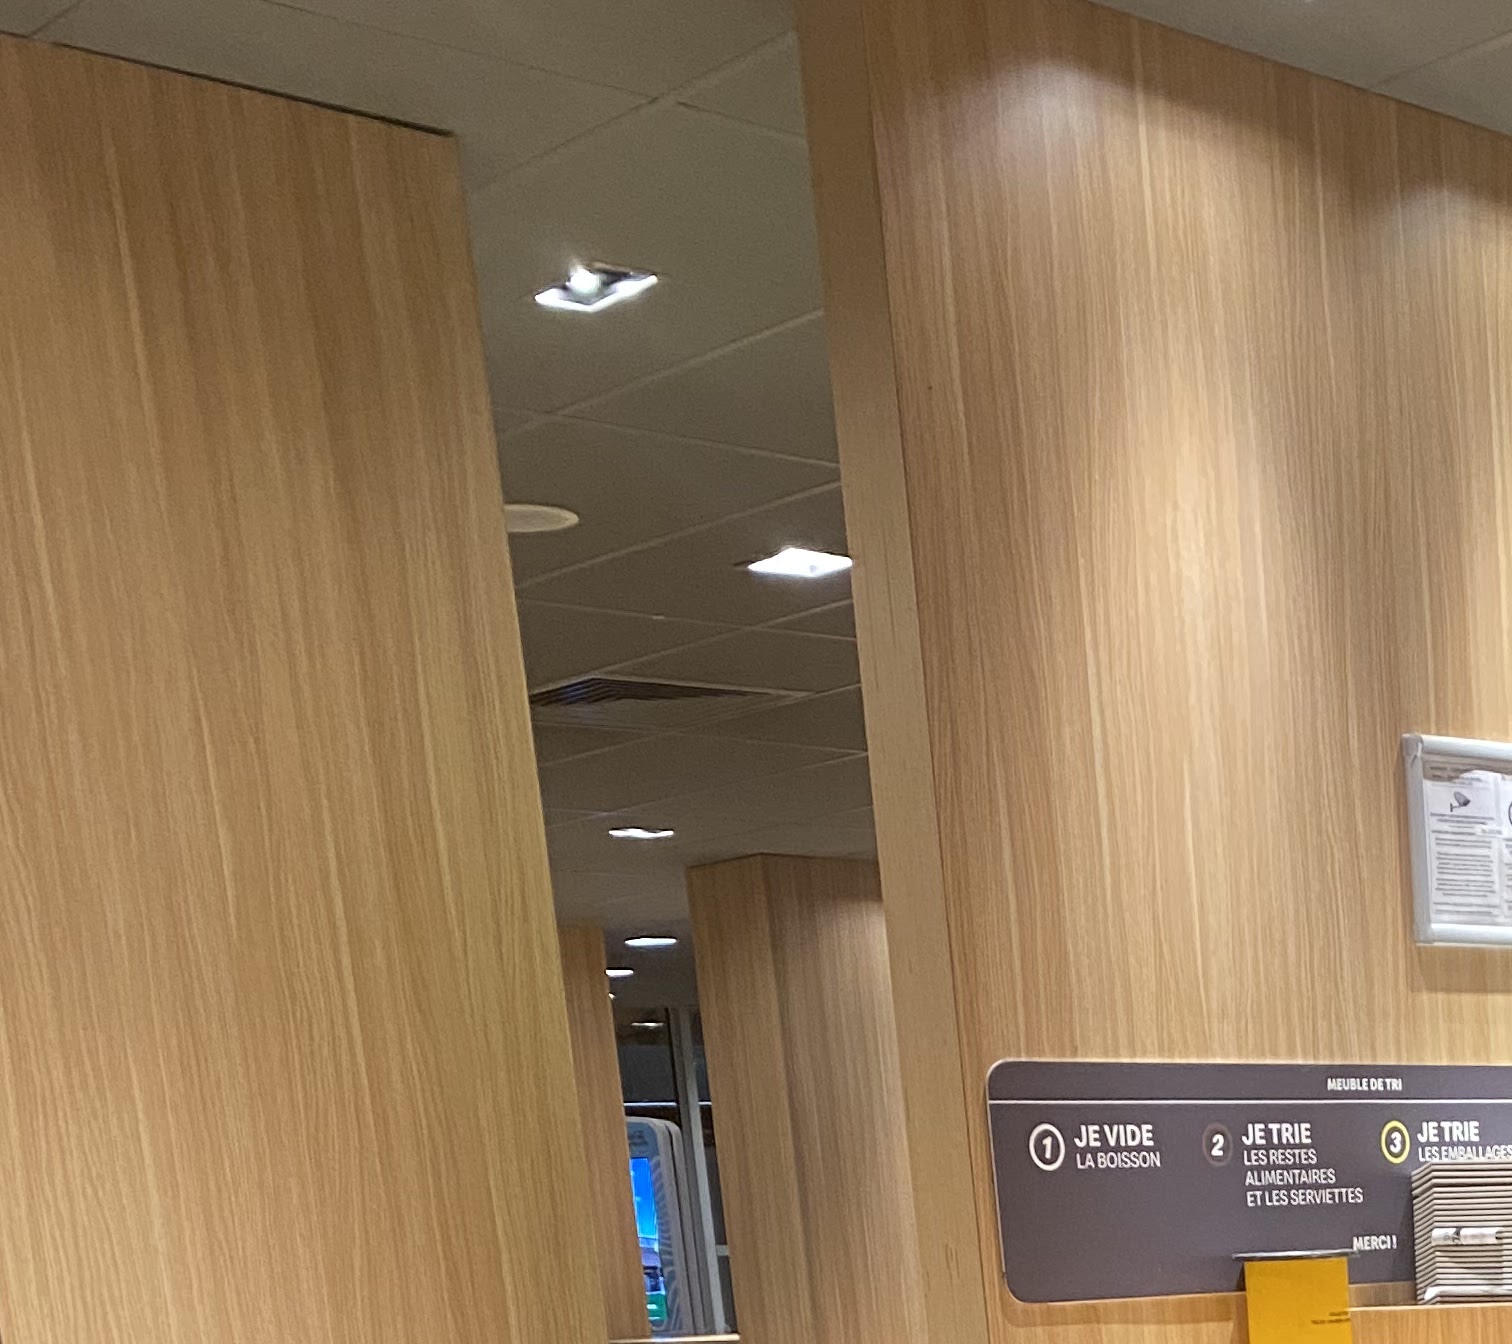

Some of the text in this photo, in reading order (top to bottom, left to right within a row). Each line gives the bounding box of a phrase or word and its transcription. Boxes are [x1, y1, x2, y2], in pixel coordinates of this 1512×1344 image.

[1327, 1078, 1403, 1090] MEUBLE DE TRI
[1074, 1124, 1154, 1147] JE VIDE
[1242, 1122, 1312, 1145] JE TRIE
[1417, 1121, 1480, 1142] JE TRIE
[1042, 1136, 1052, 1159] 1
[1211, 1134, 1225, 1156] 2
[1390, 1131, 1401, 1153] 3
[1076, 1151, 1161, 1169] LA BOISSON
[1244, 1149, 1317, 1166] LES RESTES
[1418, 1146, 1440, 1162] LES
[1245, 1168, 1336, 1186] ALIMENTAIRES
[1247, 1188, 1363, 1207] ET LES SERVIETTES
